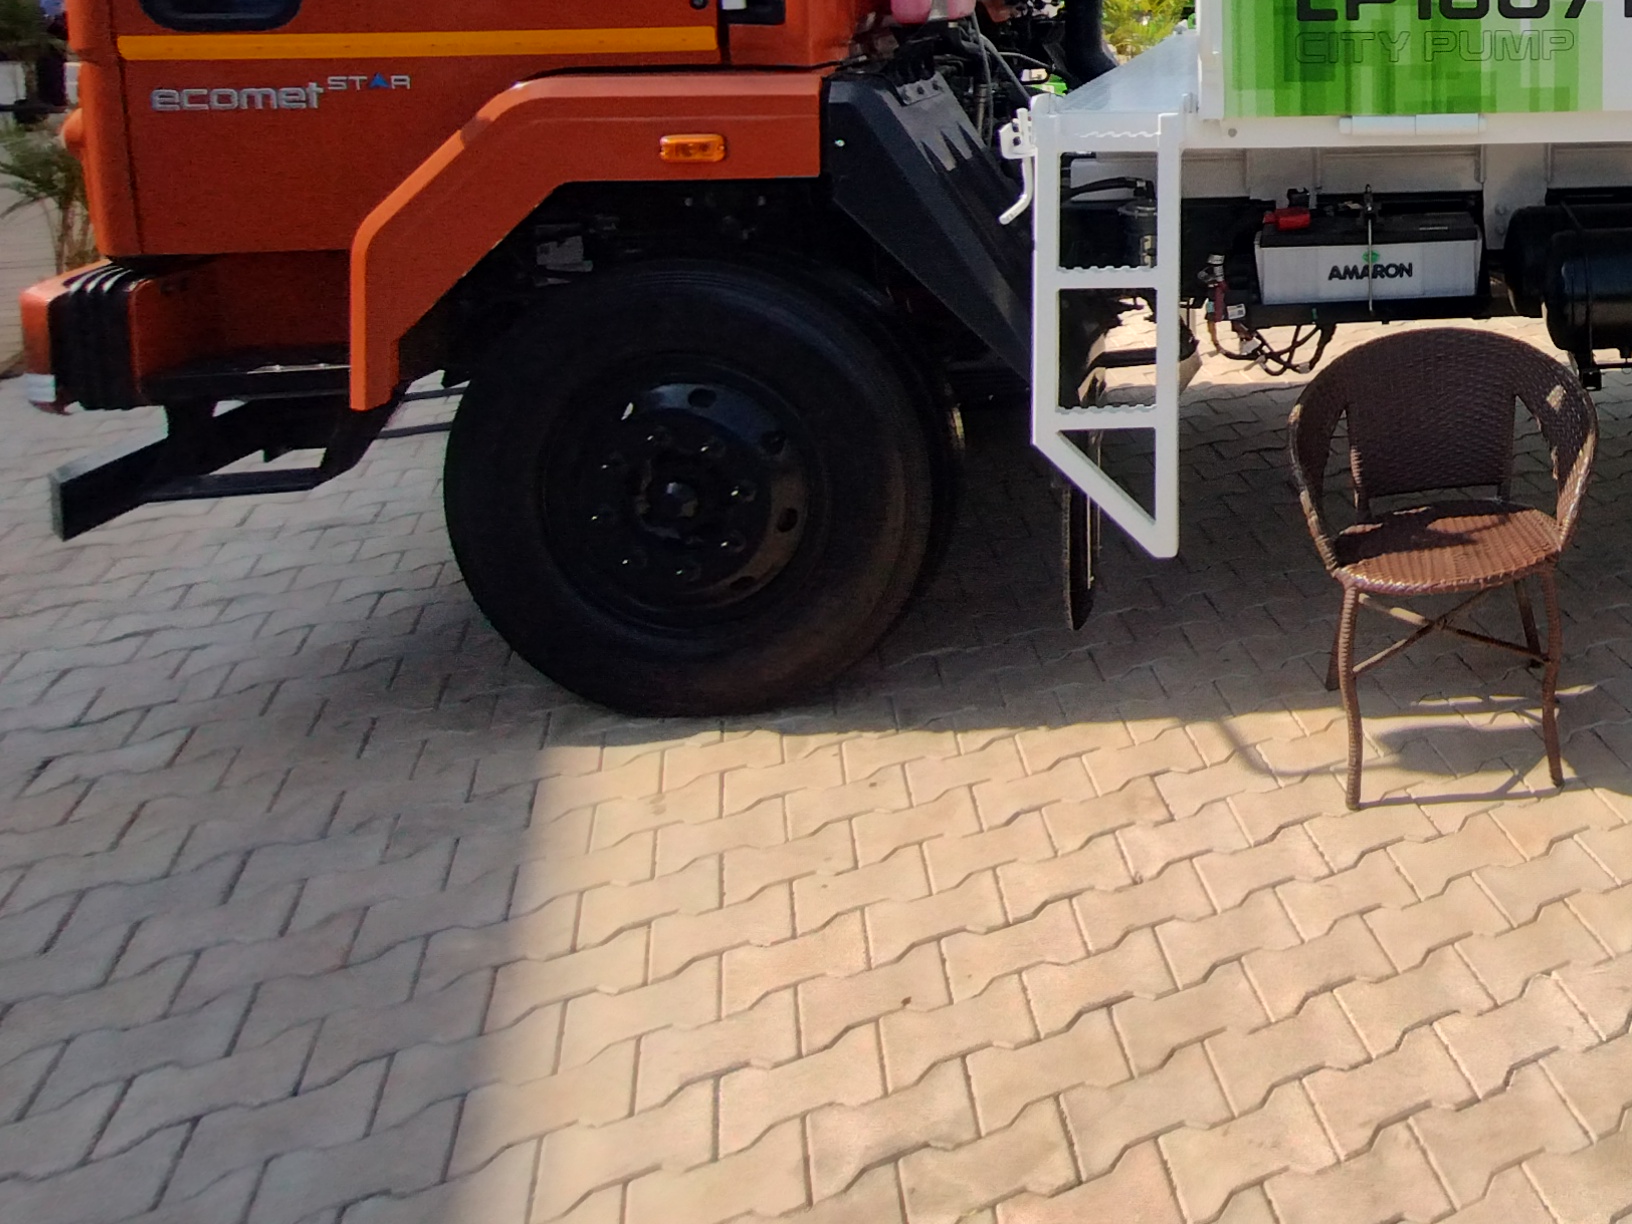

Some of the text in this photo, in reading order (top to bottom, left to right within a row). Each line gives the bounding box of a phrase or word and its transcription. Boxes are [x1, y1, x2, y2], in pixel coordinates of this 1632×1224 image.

[1295, 29, 1575, 64] CITY PUMP
[150, 82, 324, 111] ecomet
[1328, 262, 1412, 280] AMARON
